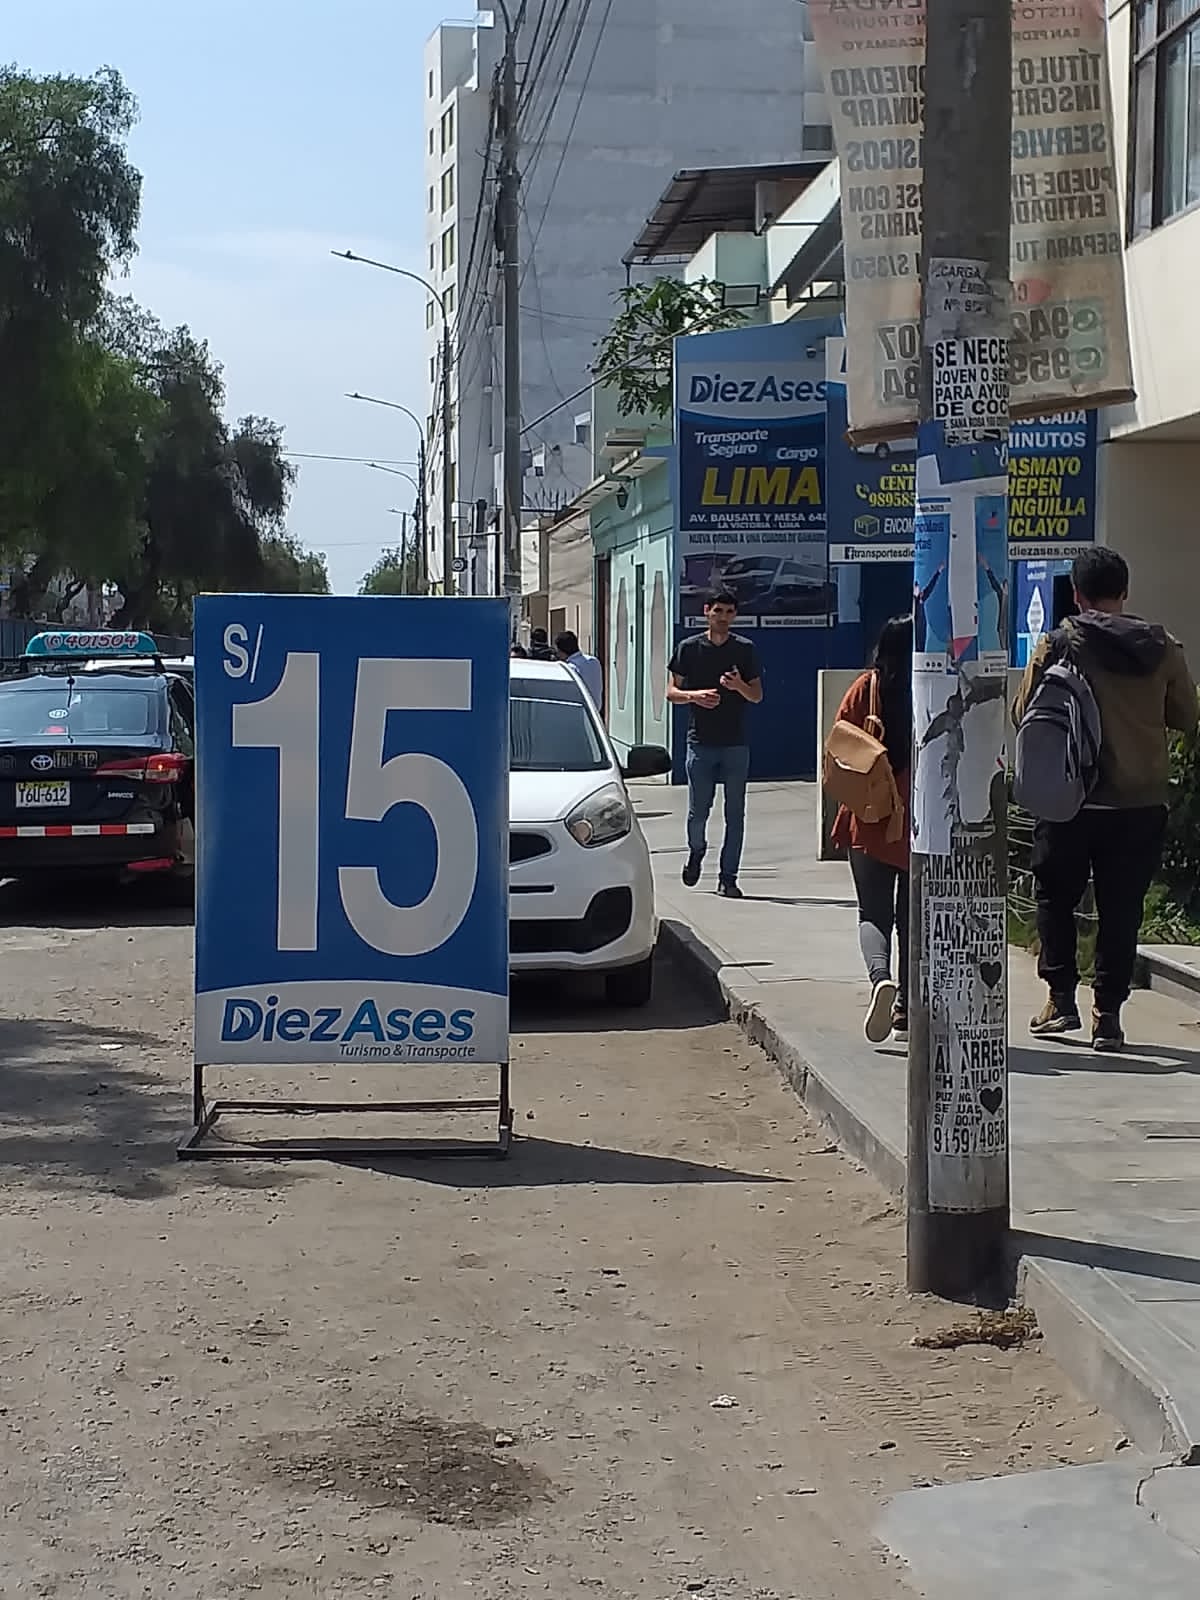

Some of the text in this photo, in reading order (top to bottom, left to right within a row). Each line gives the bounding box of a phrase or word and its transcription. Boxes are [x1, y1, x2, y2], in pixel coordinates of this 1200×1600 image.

[935, 341, 958, 368] SE
[935, 368, 977, 386] JOVEN
[981, 367, 990, 382] O
[689, 373, 828, 403] DiezAses
[935, 384, 974, 402] PARA
[936, 401, 964, 418] DE
[694, 429, 769, 445] Transporte
[708, 444, 818, 462] Seguro Cargo
[702, 466, 822, 505] LIMA
[1011, 497, 1086, 517] NGUILLA
[689, 513, 708, 523] AV.
[711, 513, 761, 522] BAUSATE
[774, 513, 806, 522] MESA
[65, 633, 139, 649] 401504
[231, 651, 480, 957] 15
[963, 880, 999, 897] MAYR
[221, 994, 477, 1041] DiezAses
[339, 1043, 476, 1059] Turismo & Transporte
